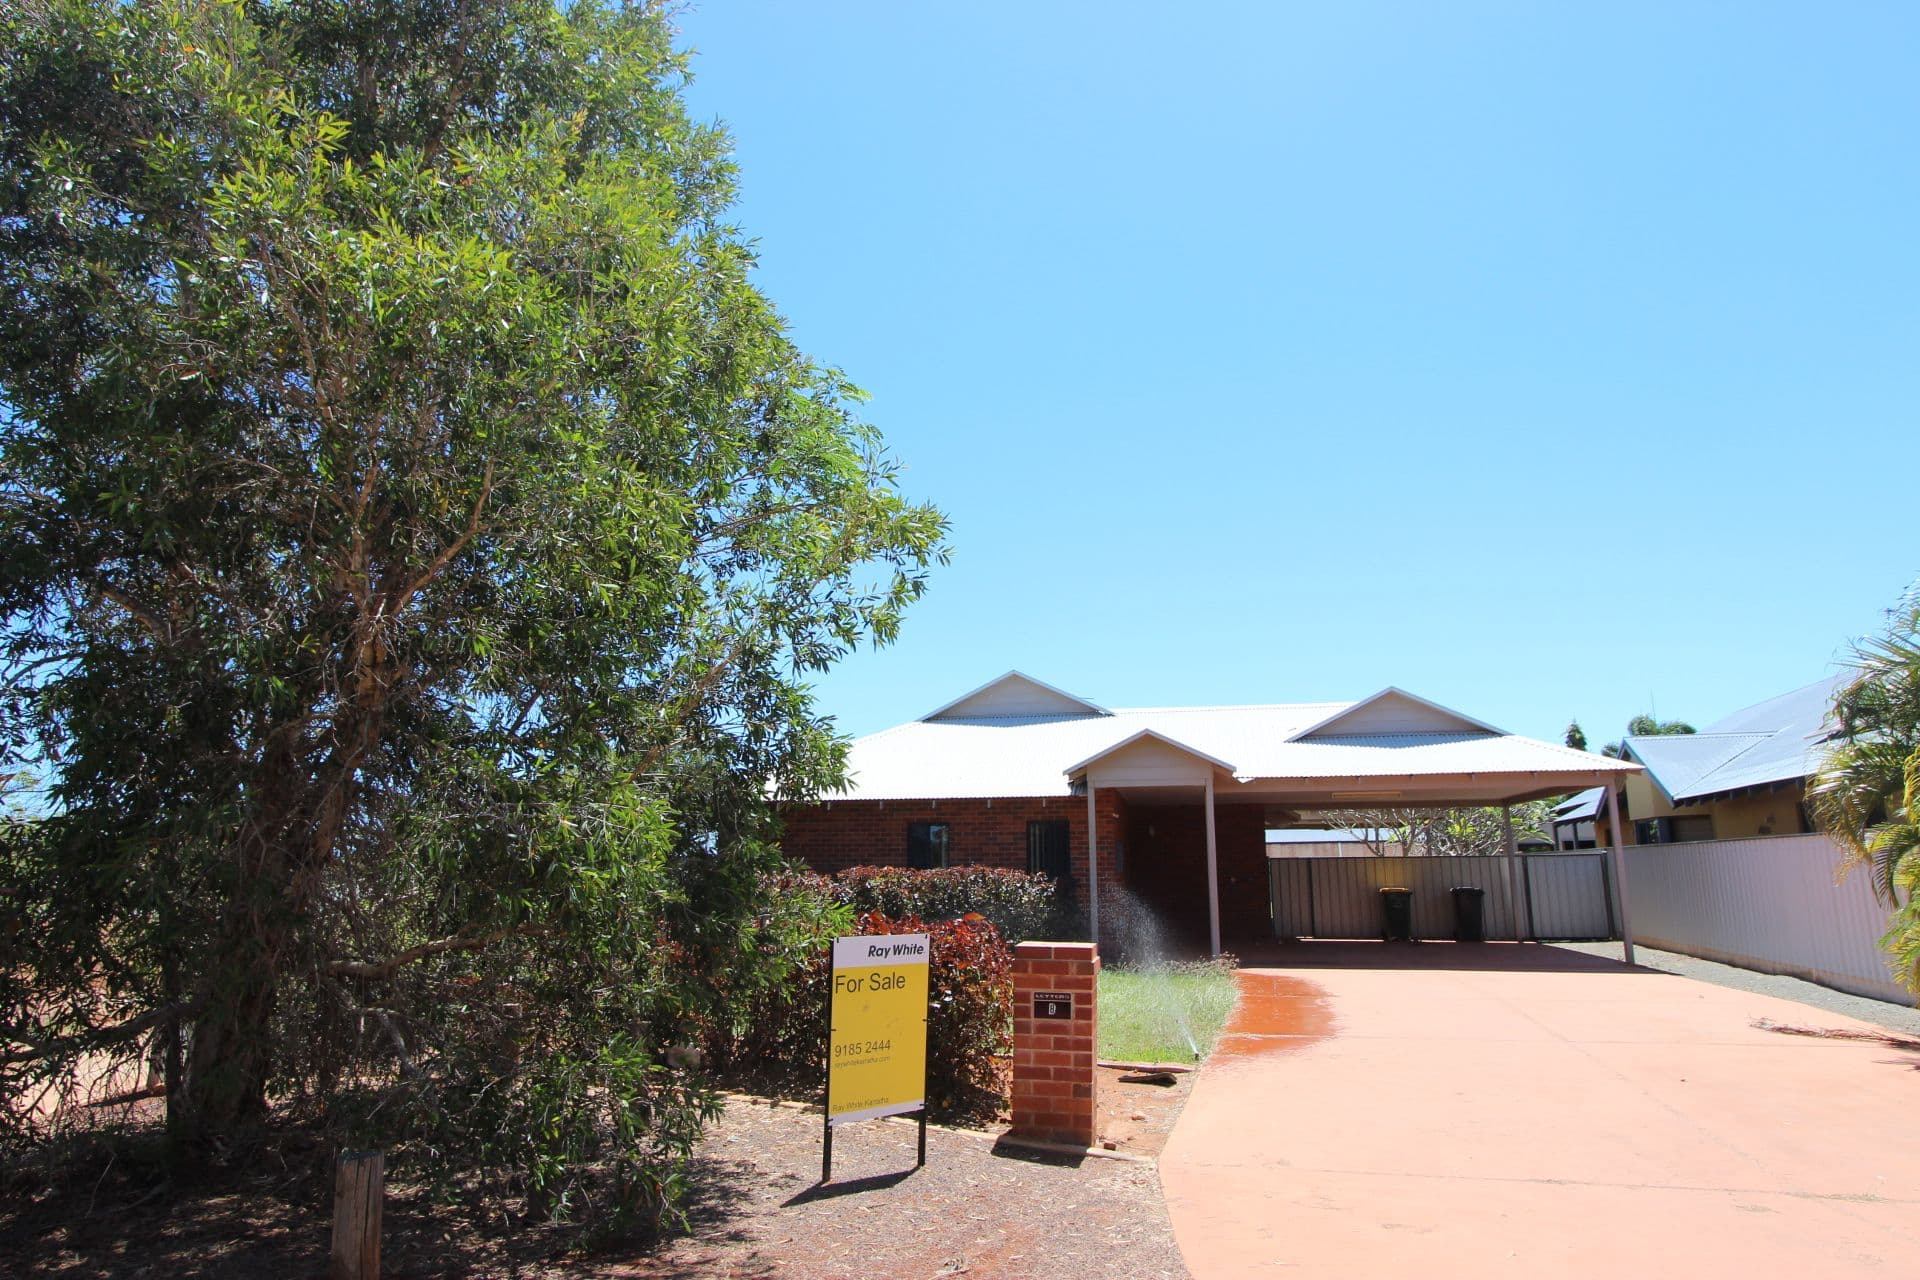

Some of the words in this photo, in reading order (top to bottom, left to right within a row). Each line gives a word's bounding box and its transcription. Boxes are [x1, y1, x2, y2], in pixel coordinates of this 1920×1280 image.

[868, 945, 891, 959] Ray
[893, 943, 924, 956] White
[835, 974, 864, 994] For
[869, 971, 906, 991] Sale
[834, 1042, 862, 1057] 9185
[865, 1040, 891, 1054] 2444
